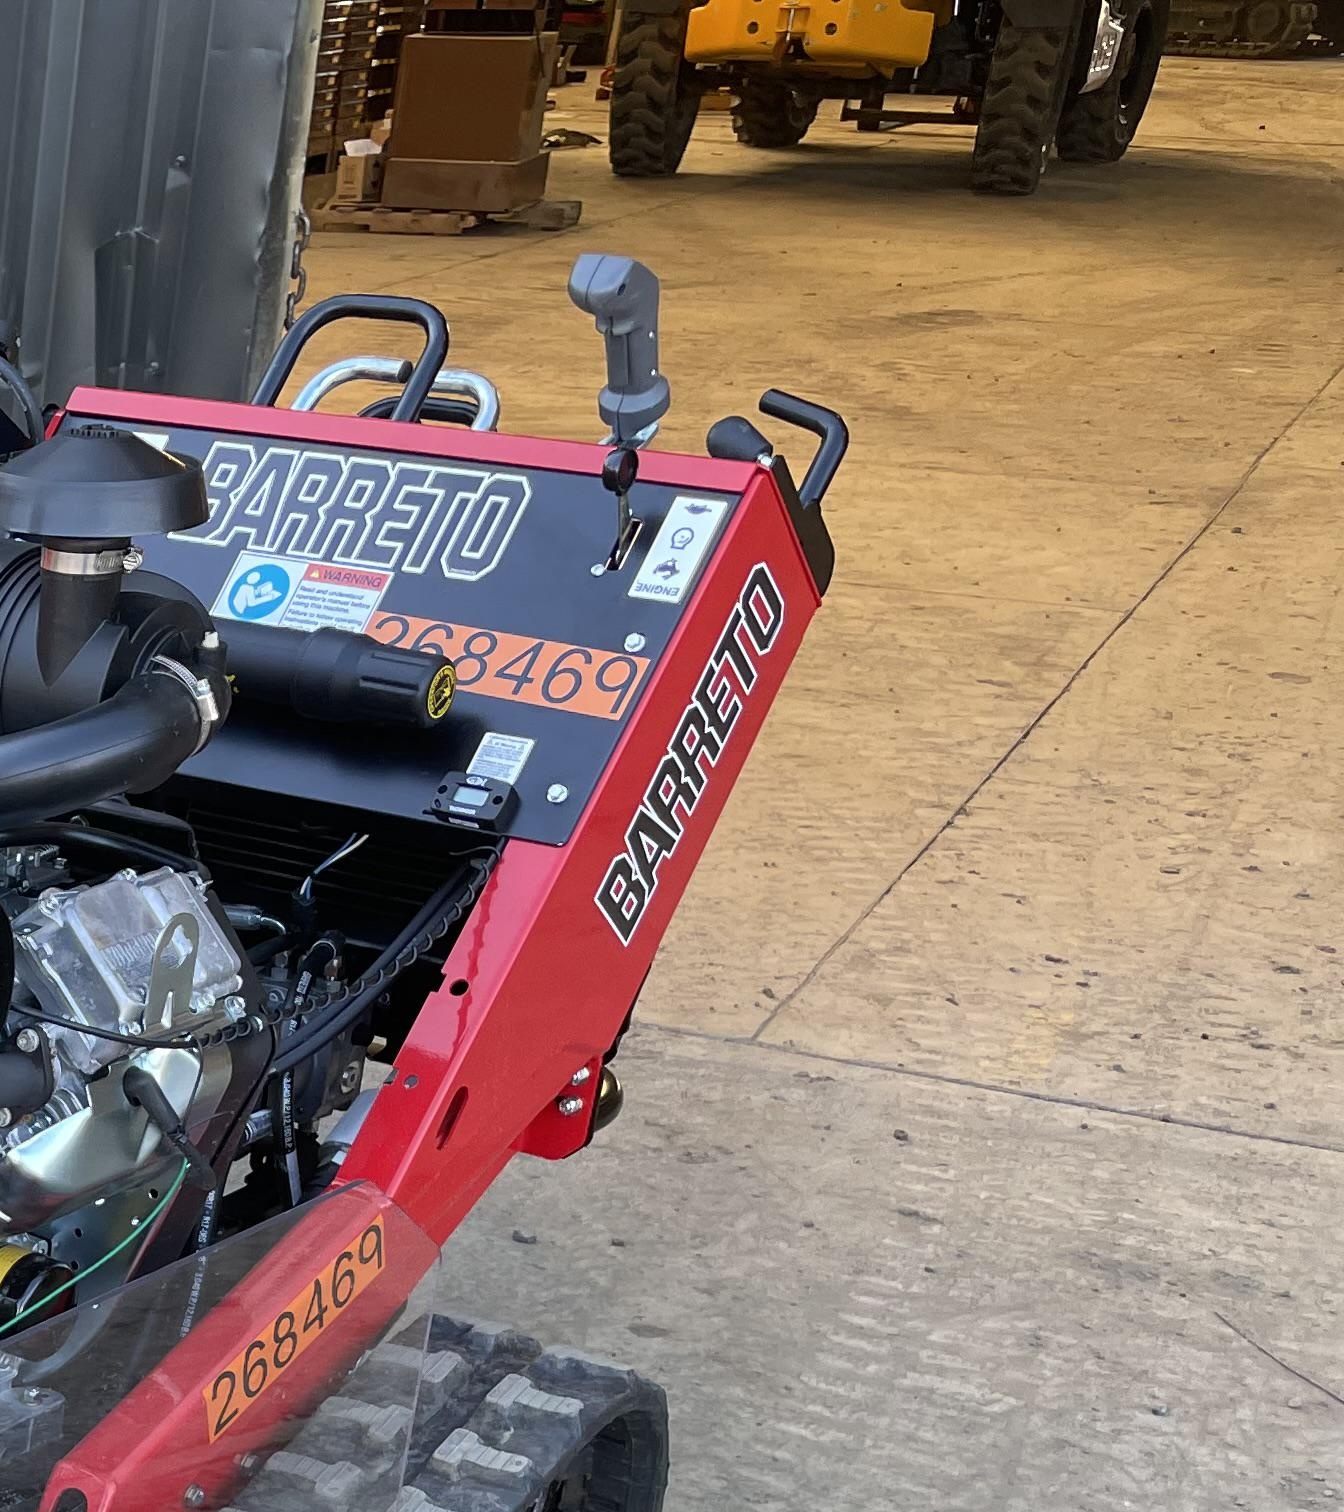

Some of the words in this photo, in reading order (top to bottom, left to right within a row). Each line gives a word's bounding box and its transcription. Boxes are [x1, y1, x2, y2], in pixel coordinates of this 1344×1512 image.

[167, 441, 533, 582] BARRETO
[323, 569, 382, 588] WARNING
[634, 582, 680, 597] ENGINE
[593, 560, 785, 949] BARRETO
[211, 1223, 383, 1437] 268469
